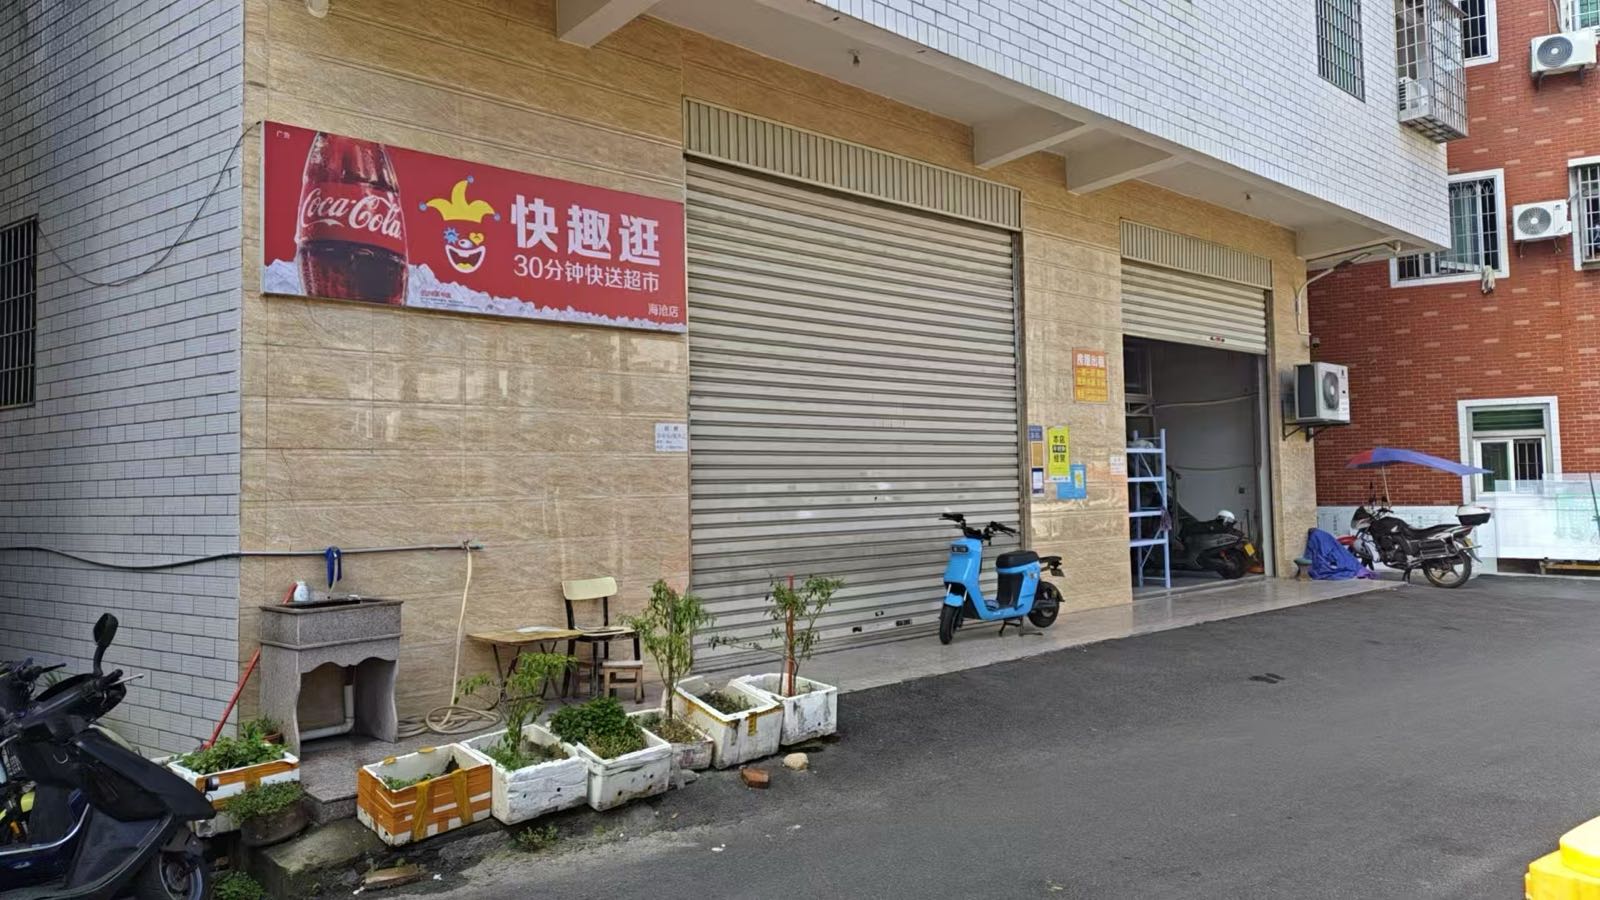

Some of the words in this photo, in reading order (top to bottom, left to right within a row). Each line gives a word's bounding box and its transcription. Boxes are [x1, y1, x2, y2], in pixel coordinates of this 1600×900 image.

[301, 188, 402, 240] Coca-Cola
[510, 194, 660, 266] 快趣逛
[513, 254, 660, 292] 30分钟快送超市
[648, 303, 679, 318] 海沧店
